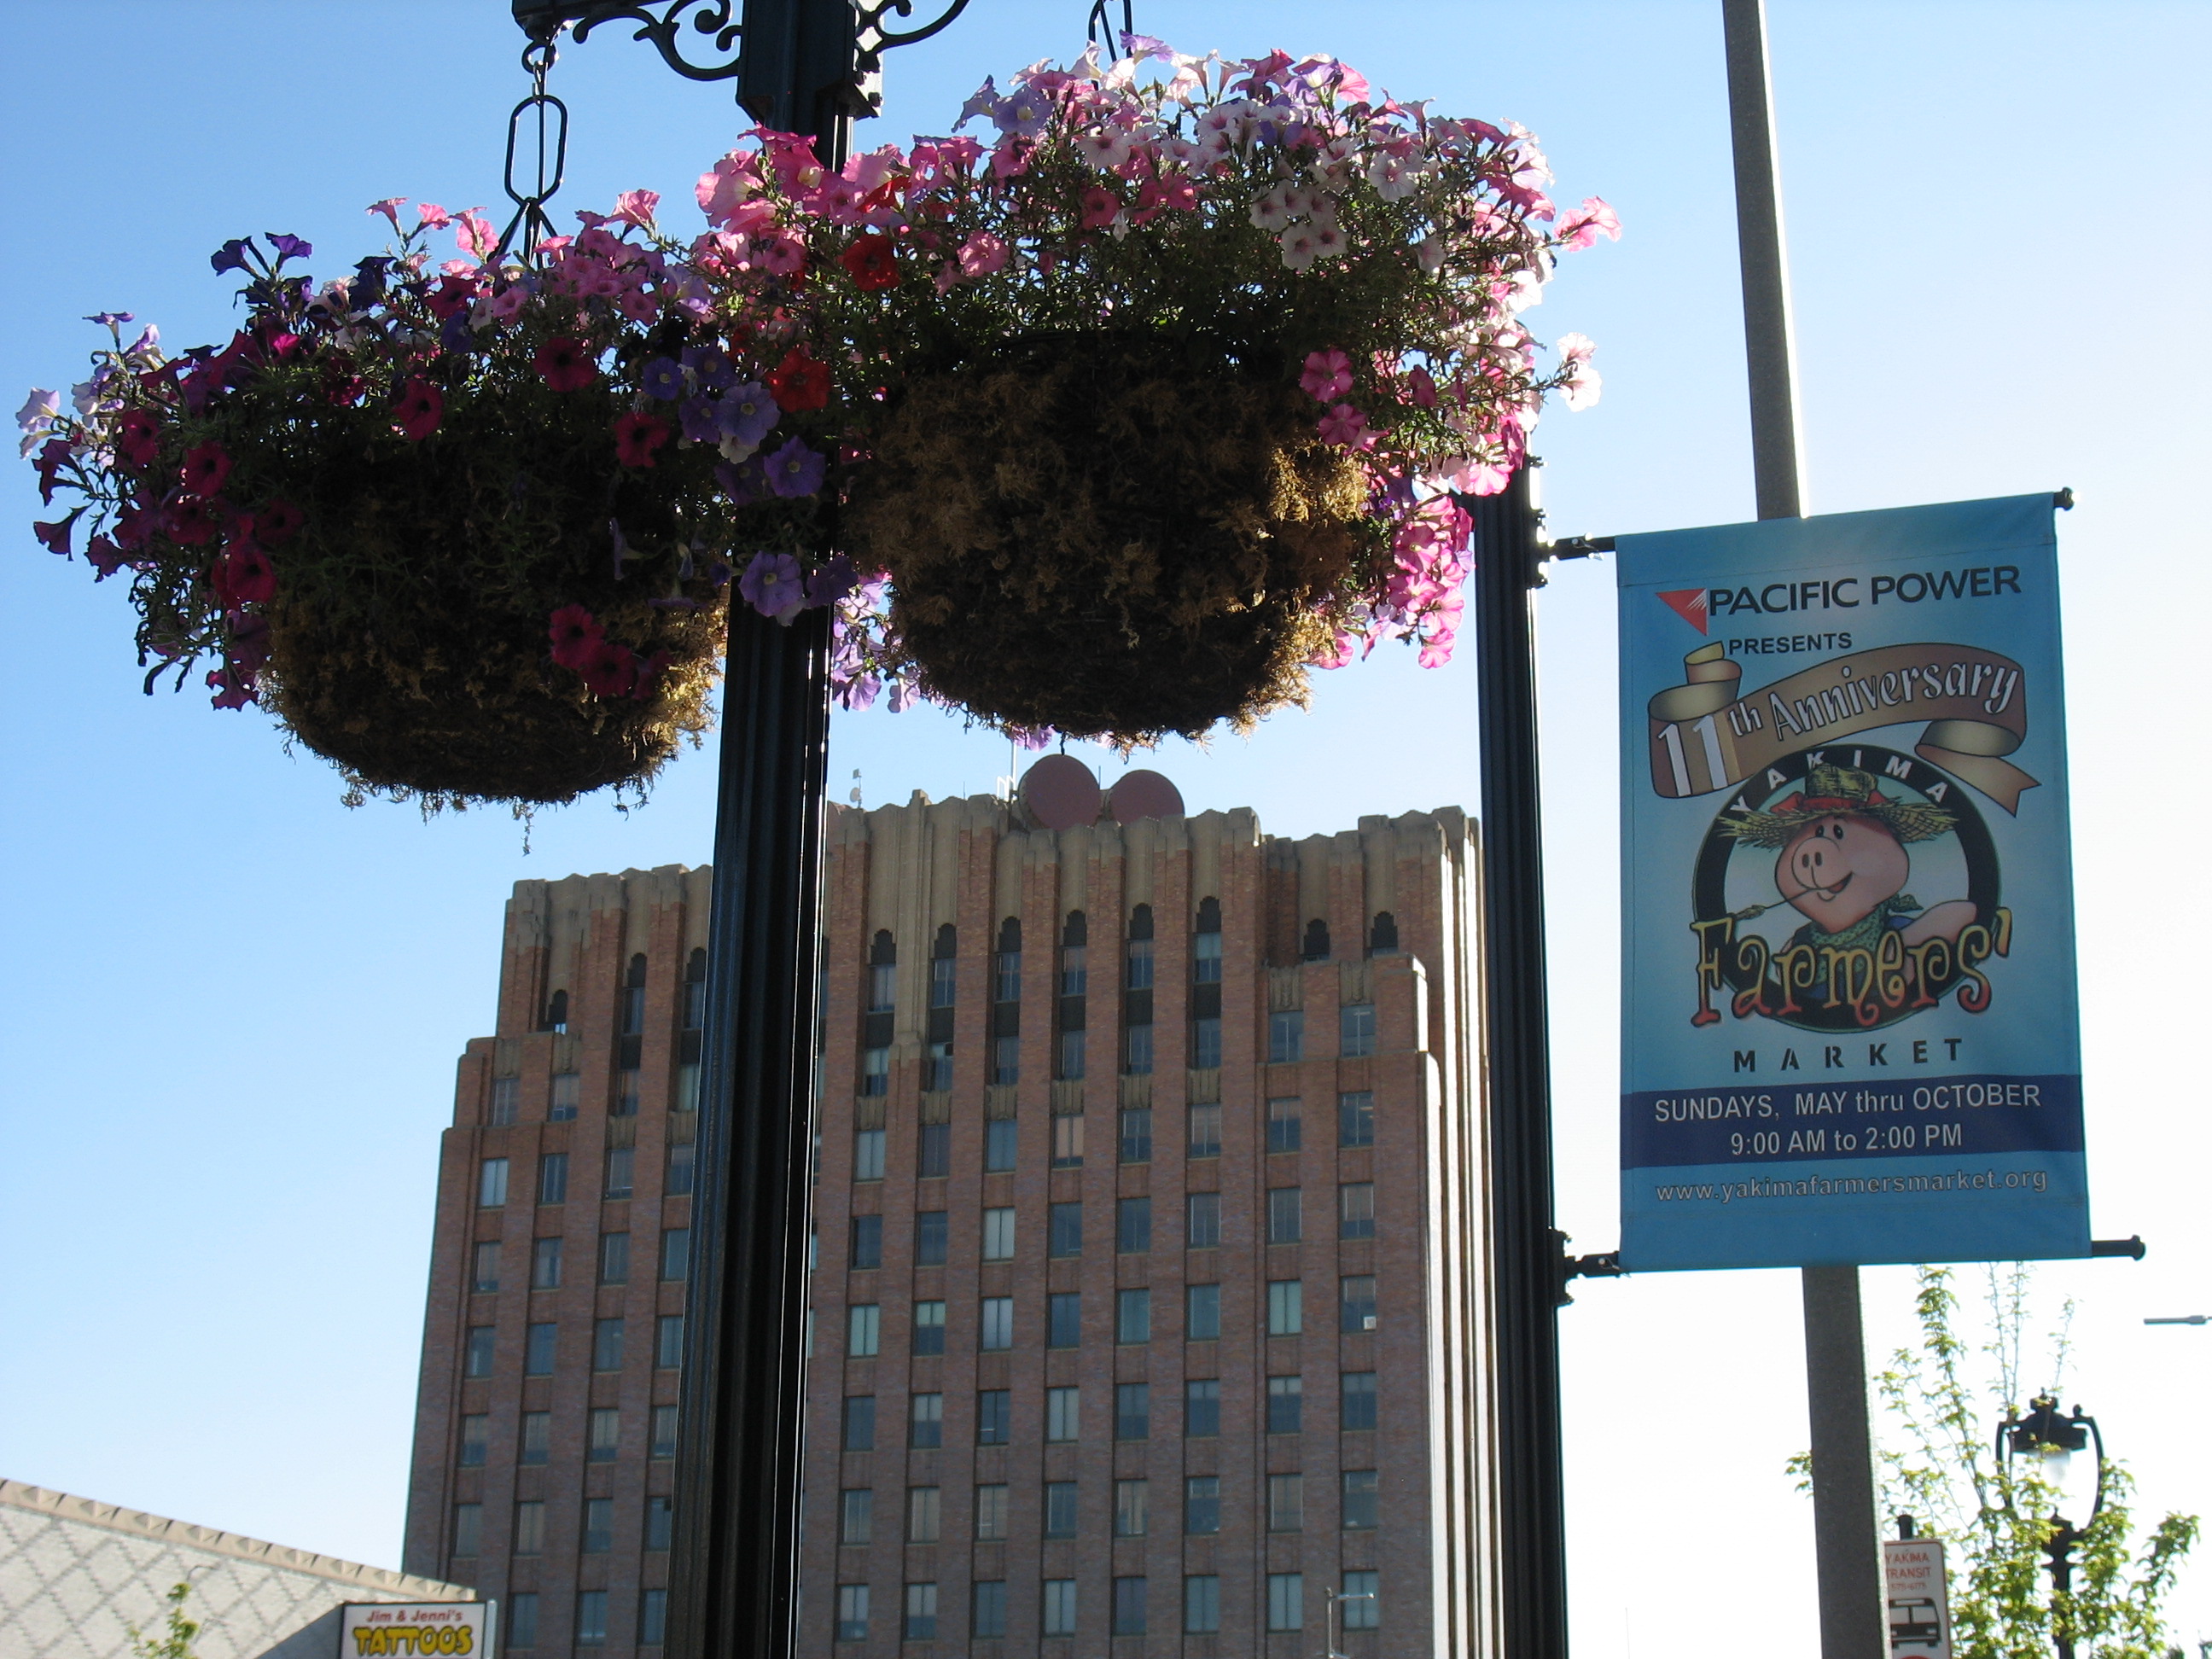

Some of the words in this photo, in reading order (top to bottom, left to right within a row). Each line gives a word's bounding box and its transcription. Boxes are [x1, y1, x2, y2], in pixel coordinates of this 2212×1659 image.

[1709, 578, 1860, 616] PACIFIC
[1871, 566, 2022, 605] POWER
[1729, 632, 1852, 655] PRESENTS
[1658, 700, 1762, 797] 11th
[1770, 661, 2019, 741] Anniversary
[1730, 749, 1948, 812] YAKIMA
[1734, 1038, 1962, 1073] MARKET
[1655, 1094, 1779, 1122] SUNDAYS,
[1795, 1091, 1848, 1116] MAY
[1855, 1089, 1904, 1113] thru
[1912, 1084, 2040, 1110] OCTOBER
[1731, 1132, 1781, 1155] 9:00
[1788, 1129, 1825, 1154] AM
[1833, 1129, 1857, 1150] to
[1865, 1126, 1916, 1150] 2:00
[1925, 1123, 1962, 1148] PM
[1656, 1169, 2047, 1204] www.yakimafarmersmarket.org
[1885, 1552, 1930, 1563] YAKIMA
[1886, 1567, 1931, 1579] TRANSIT
[366, 1610, 392, 1622] Jim
[396, 1610, 406, 1621] &
[410, 1610, 463, 1621] Jenni's
[353, 1625, 474, 1656] TATTOOS
